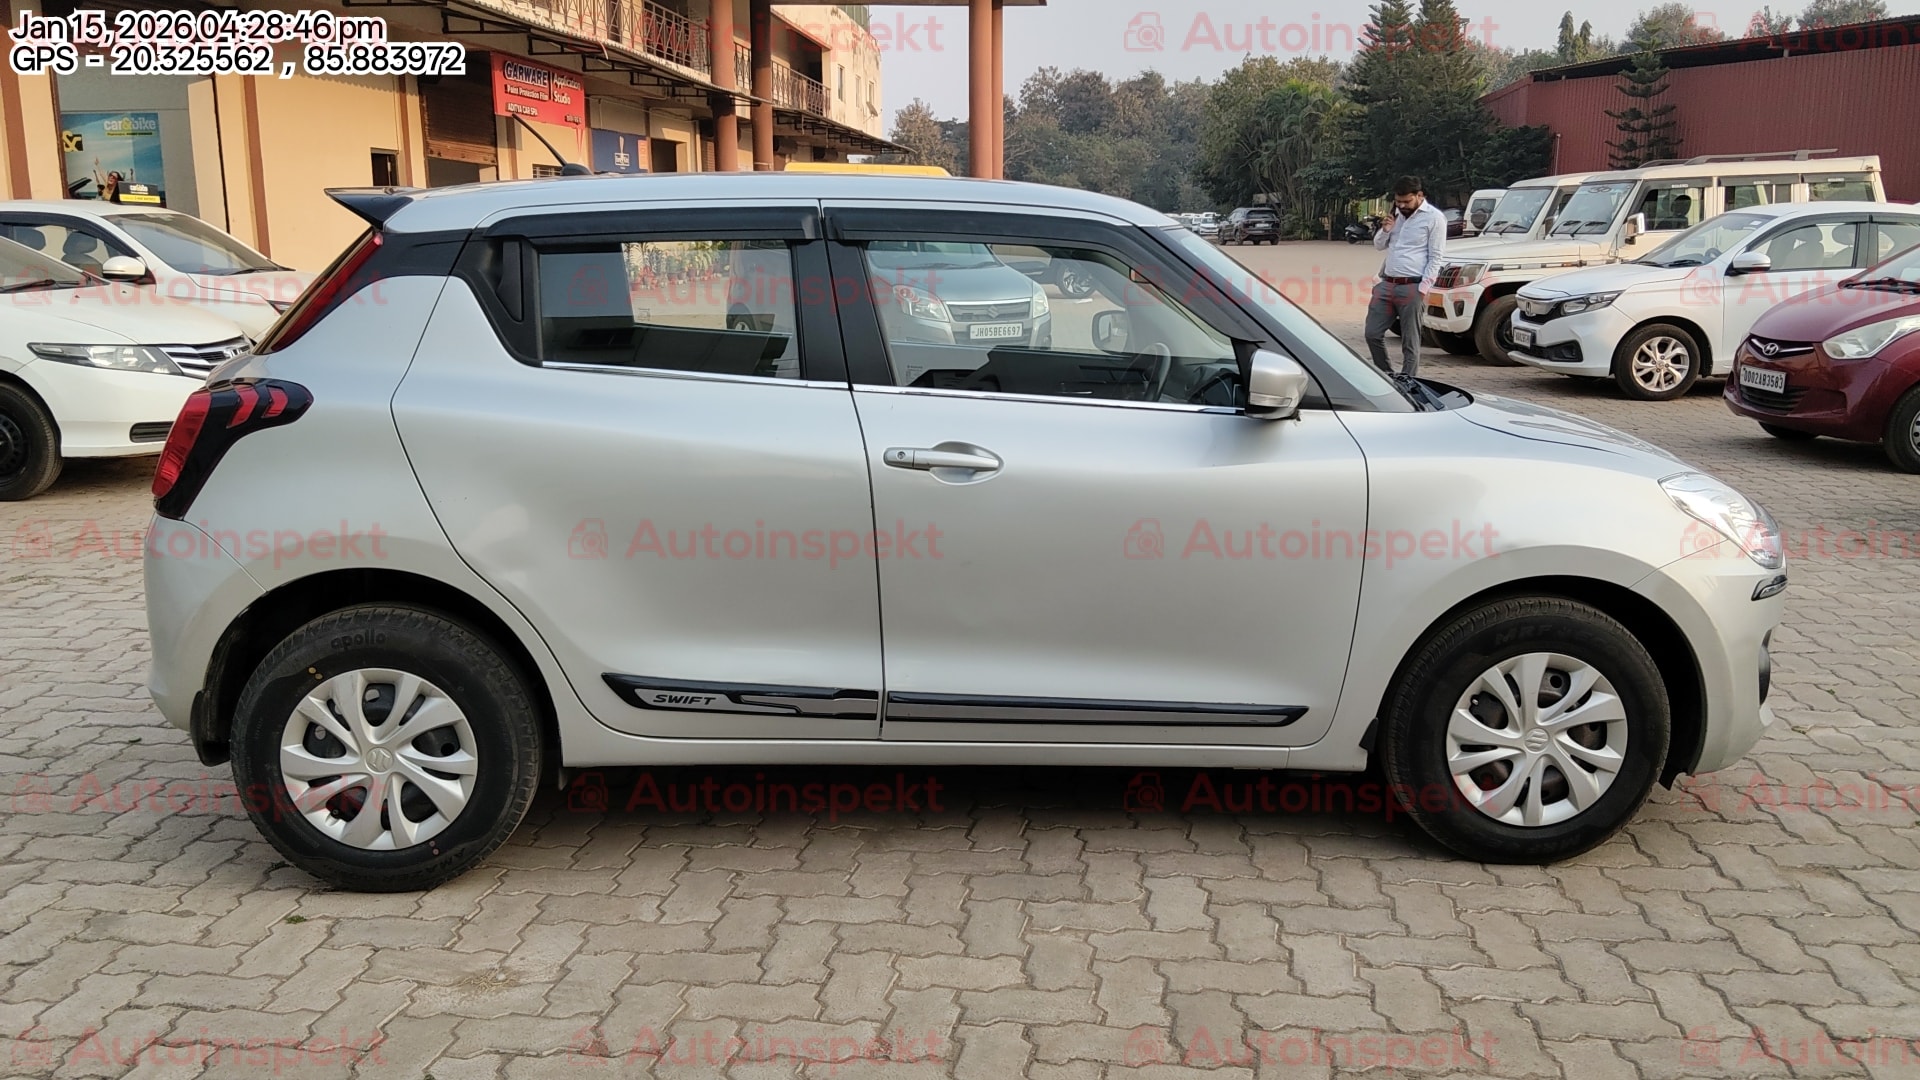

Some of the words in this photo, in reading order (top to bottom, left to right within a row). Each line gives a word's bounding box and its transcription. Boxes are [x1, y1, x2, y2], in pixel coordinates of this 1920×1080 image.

[504, 61, 549, 88] GARWARE
[553, 91, 571, 105] Studio
[103, 117, 156, 131] car&bike
[975, 326, 1021, 337] JH05BE6697
[330, 628, 387, 651] apollo
[652, 694, 717, 706] SWIFT
